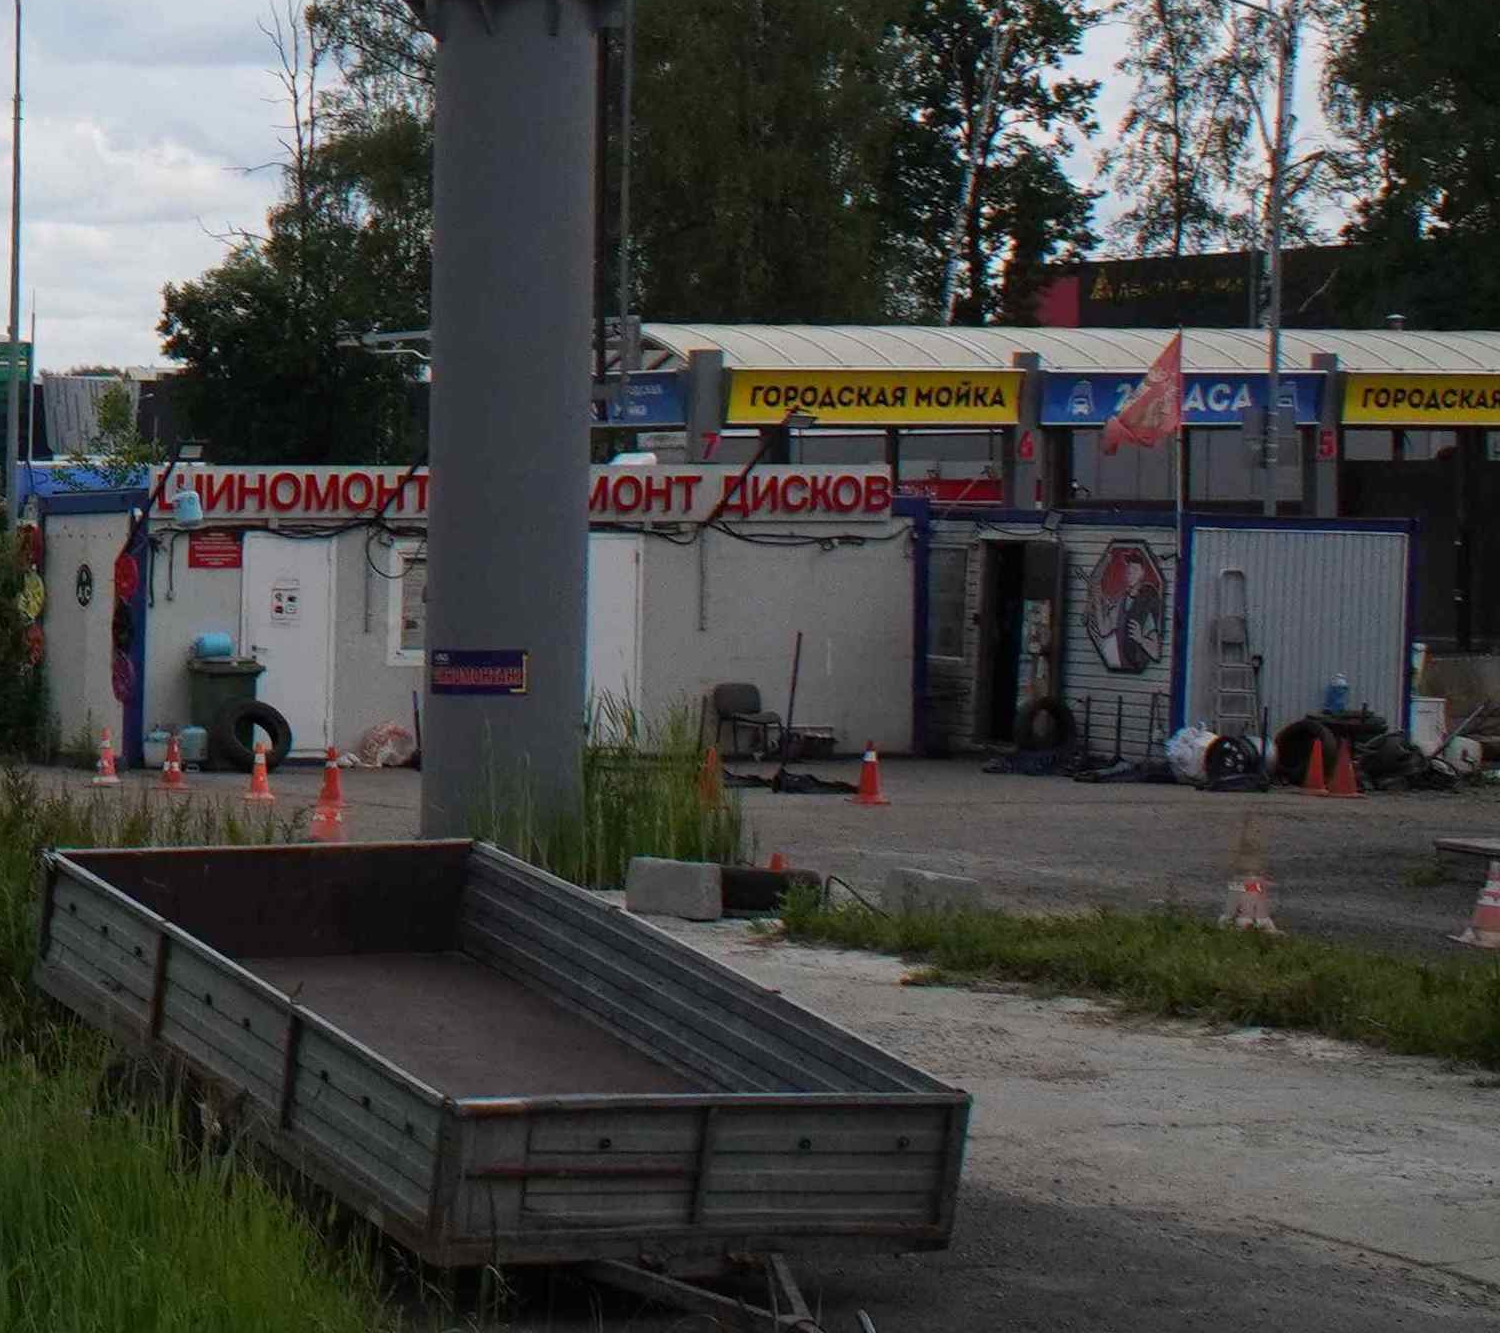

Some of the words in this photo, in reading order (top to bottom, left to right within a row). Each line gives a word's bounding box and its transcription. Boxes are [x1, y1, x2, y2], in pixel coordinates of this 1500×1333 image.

[751, 385, 908, 409] ГОРОДСКАЯ
[915, 381, 1007, 409] МОЙКА
[156, 471, 430, 513] ШИНОМОНТ
[722, 475, 891, 517] ДИСКОВ
